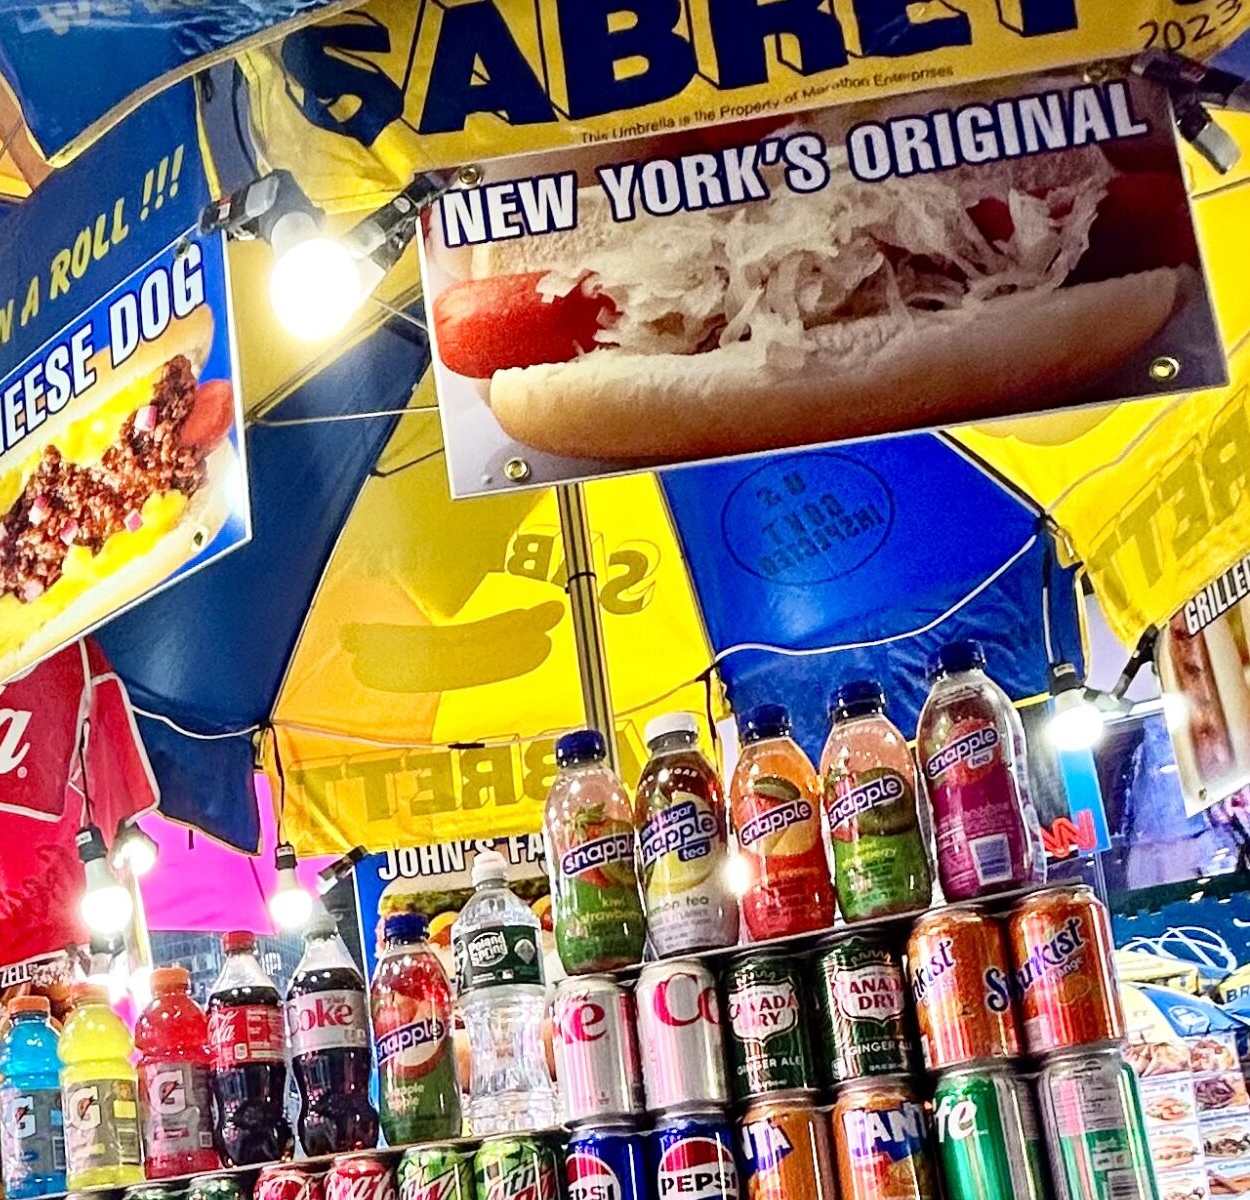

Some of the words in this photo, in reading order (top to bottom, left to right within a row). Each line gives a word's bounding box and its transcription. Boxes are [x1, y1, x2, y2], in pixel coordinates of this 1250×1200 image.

[612, 116, 675, 140] Umbrella
[693, 108, 716, 124] the
[719, 96, 781, 121] Property
[784, 89, 800, 105] of
[442, 172, 577, 248] NEW
[599, 132, 830, 224] YORK'S
[850, 79, 1149, 182] ORIGINAL
[49, 209, 130, 299] ROLL
[109, 240, 206, 369] DOG
[926, 726, 1000, 779] snapple
[740, 801, 813, 848] snapple
[828, 774, 905, 831] snapple
[561, 832, 635, 877] snappl
[681, 843, 707, 861] tea
[660, 1171, 738, 1196] PEPSI
